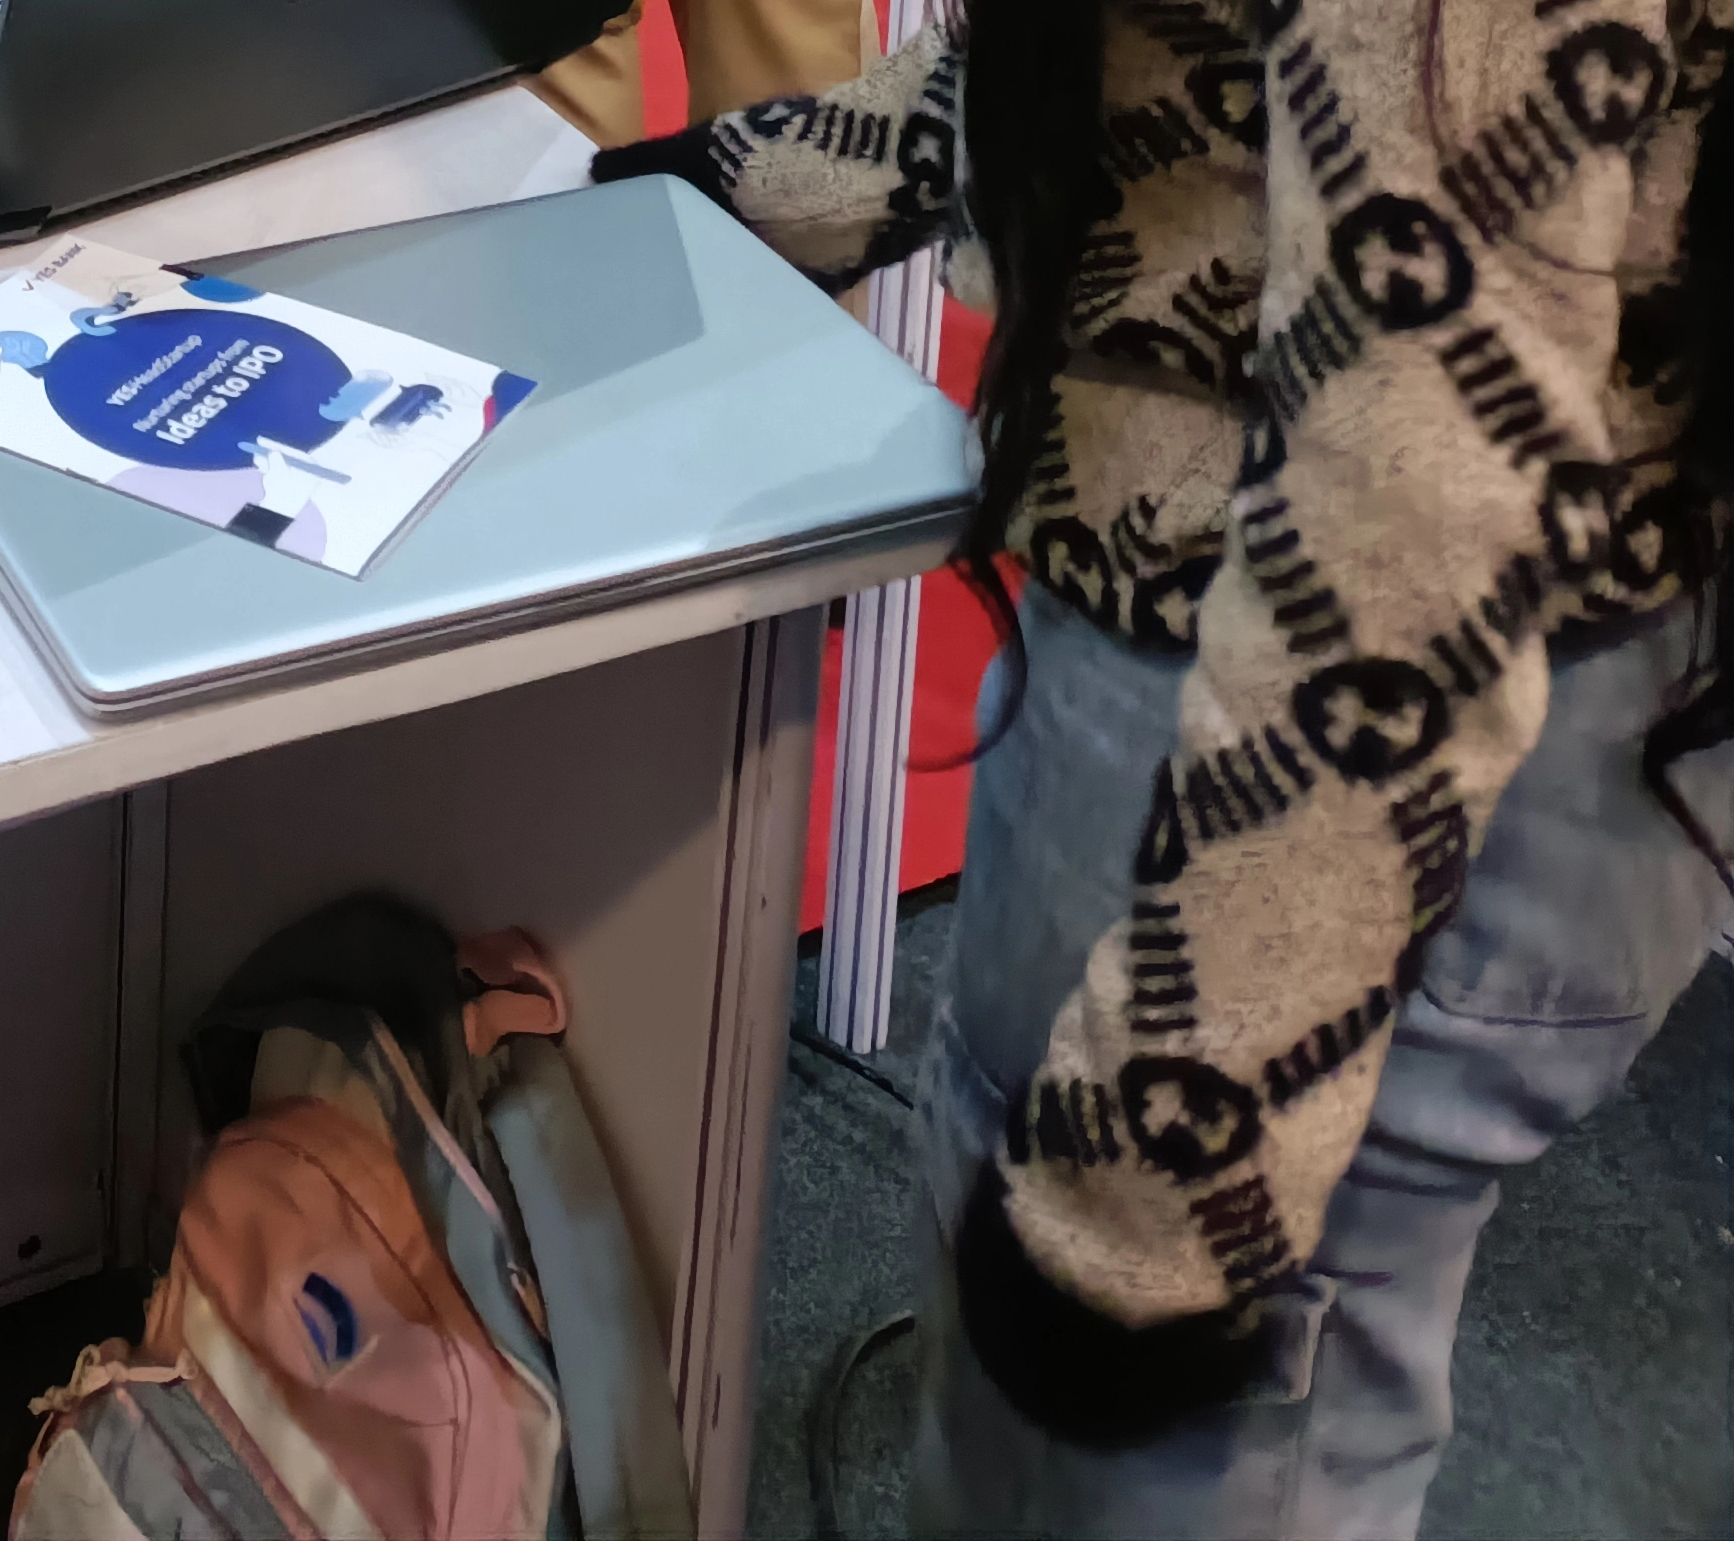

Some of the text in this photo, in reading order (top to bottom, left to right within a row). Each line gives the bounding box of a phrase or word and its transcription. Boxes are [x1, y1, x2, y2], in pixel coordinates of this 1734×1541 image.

[156, 344, 284, 446] Ideas to IPO
